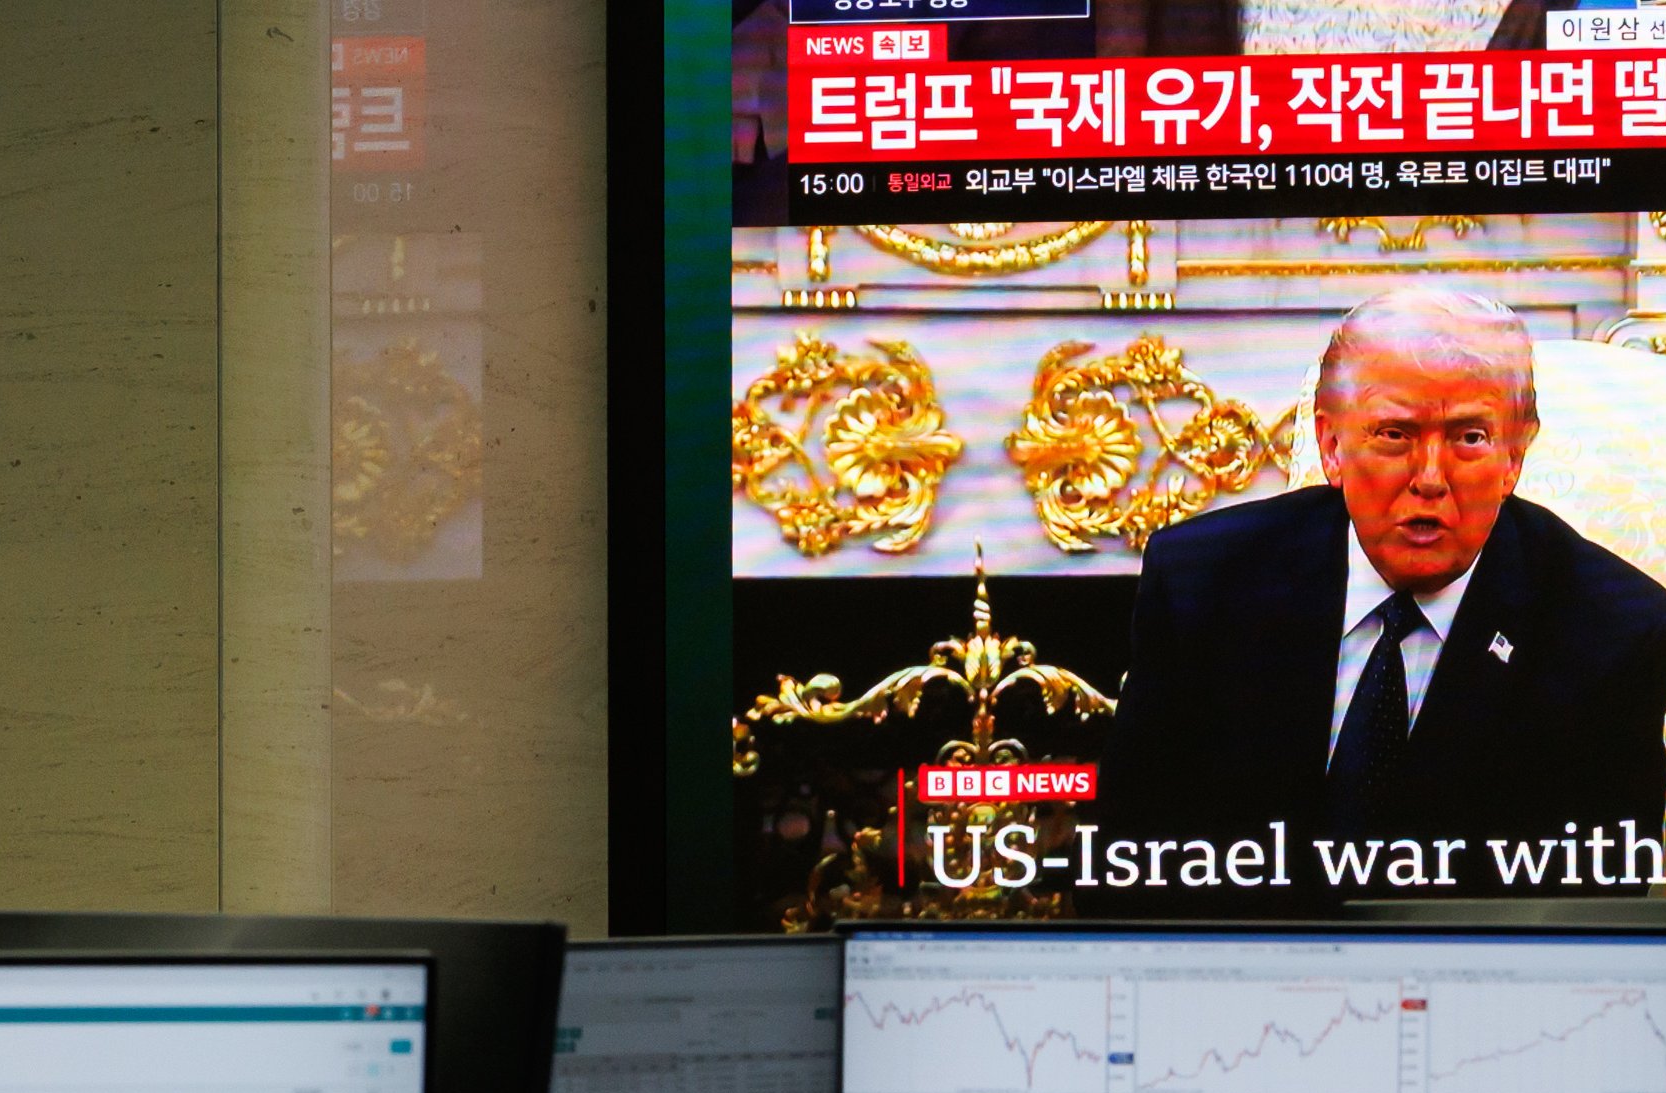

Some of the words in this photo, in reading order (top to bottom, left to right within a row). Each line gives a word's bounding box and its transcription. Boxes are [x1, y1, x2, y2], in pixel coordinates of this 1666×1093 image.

[806, 37, 864, 56] NEWS
[878, 34, 925, 54] 속보
[803, 72, 979, 151] 트럼프
[990, 66, 1126, 148] "국제
[1140, 65, 1274, 151] 유가,
[1287, 62, 1406, 143] 작전
[1419, 59, 1594, 140] 끝나면
[800, 172, 865, 195] 15:00
[887, 172, 953, 192] 통일외교
[965, 169, 1036, 195] 외교부
[1042, 167, 1146, 193] "이스라엘
[1152, 165, 1200, 191] 체류
[1206, 163, 1277, 191] 한국인
[1285, 161, 1353, 188] 110여
[1361, 160, 1391, 190] 명,
[1396, 159, 1469, 188] 육로로
[1475, 158, 1547, 187] 이집트
[1553, 157, 1612, 185] 대피"
[929, 771, 1010, 795] BBC
[1017, 773, 1089, 794] NEWS
[927, 821, 1292, 889] US-Israel
[1313, 836, 1466, 887] war
[1485, 819, 1666, 888] with
